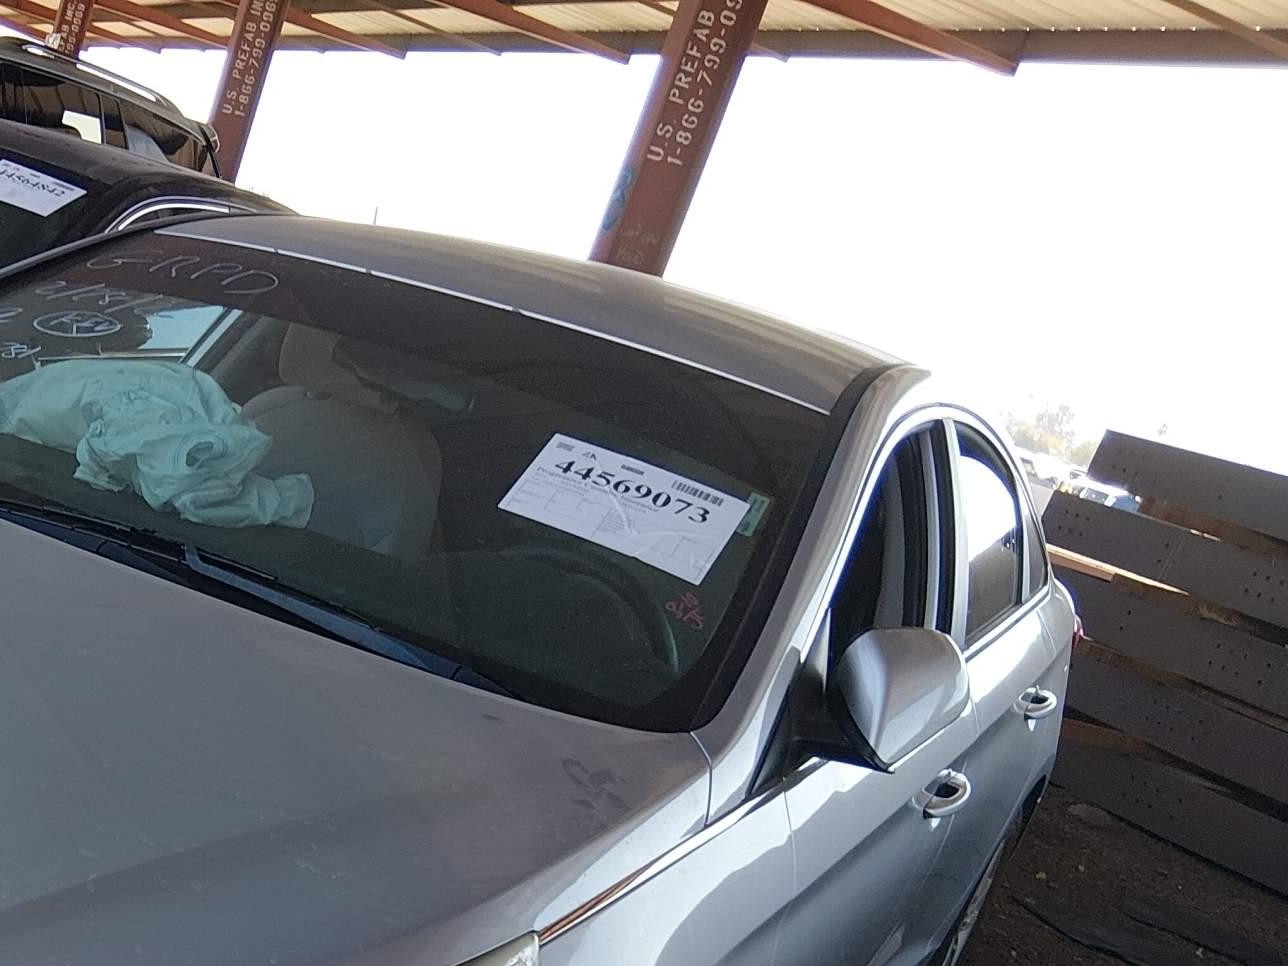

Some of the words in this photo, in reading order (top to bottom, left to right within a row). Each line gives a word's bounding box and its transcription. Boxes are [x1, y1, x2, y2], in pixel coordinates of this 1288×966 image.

[233, 22, 256, 79] PREFAB
[235, 0, 277, 116] 1-866-799-096
[669, 10, 714, 104] PREFAB
[555, 460, 710, 523] 44569073
